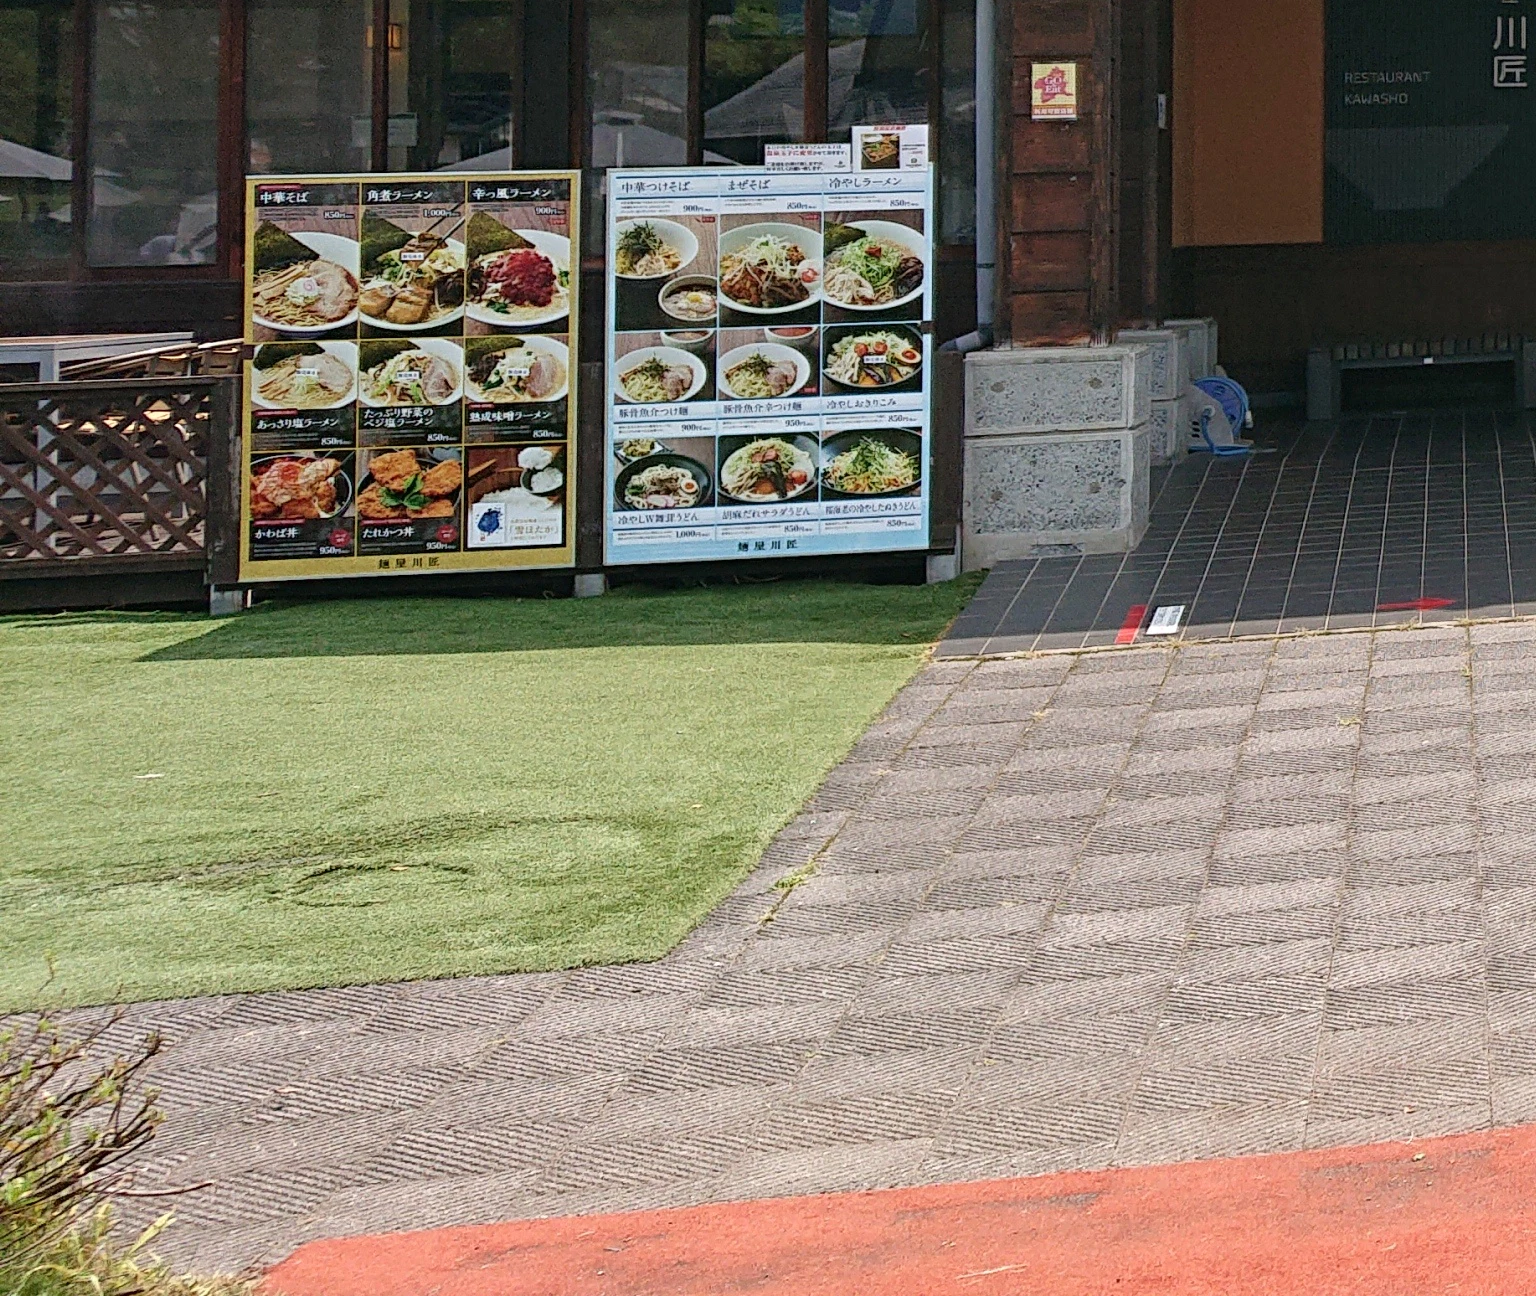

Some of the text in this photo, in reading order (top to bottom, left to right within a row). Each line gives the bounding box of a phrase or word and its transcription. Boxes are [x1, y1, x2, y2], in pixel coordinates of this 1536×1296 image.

[1493, 15, 1528, 88] 川匠
[1344, 70, 1431, 85] RESTAURANT
[1344, 92, 1409, 105] KAWASHO
[621, 180, 691, 194] 中華つけそば
[727, 179, 771, 191] まぜそば
[829, 177, 902, 189] 冷やしラーメン
[259, 191, 310, 204] 中華そば
[367, 189, 434, 202] 角煮ラーメン
[471, 187, 552, 201] 辛っ風ラーメン
[826, 398, 897, 410] 冷やしおきりこみ
[363, 407, 434, 419] たっぷり野菜の
[256, 417, 340, 430] あっさり塩ラーメン
[253, 527, 300, 540] かわば丼
[362, 526, 415, 538] たれかつ丼
